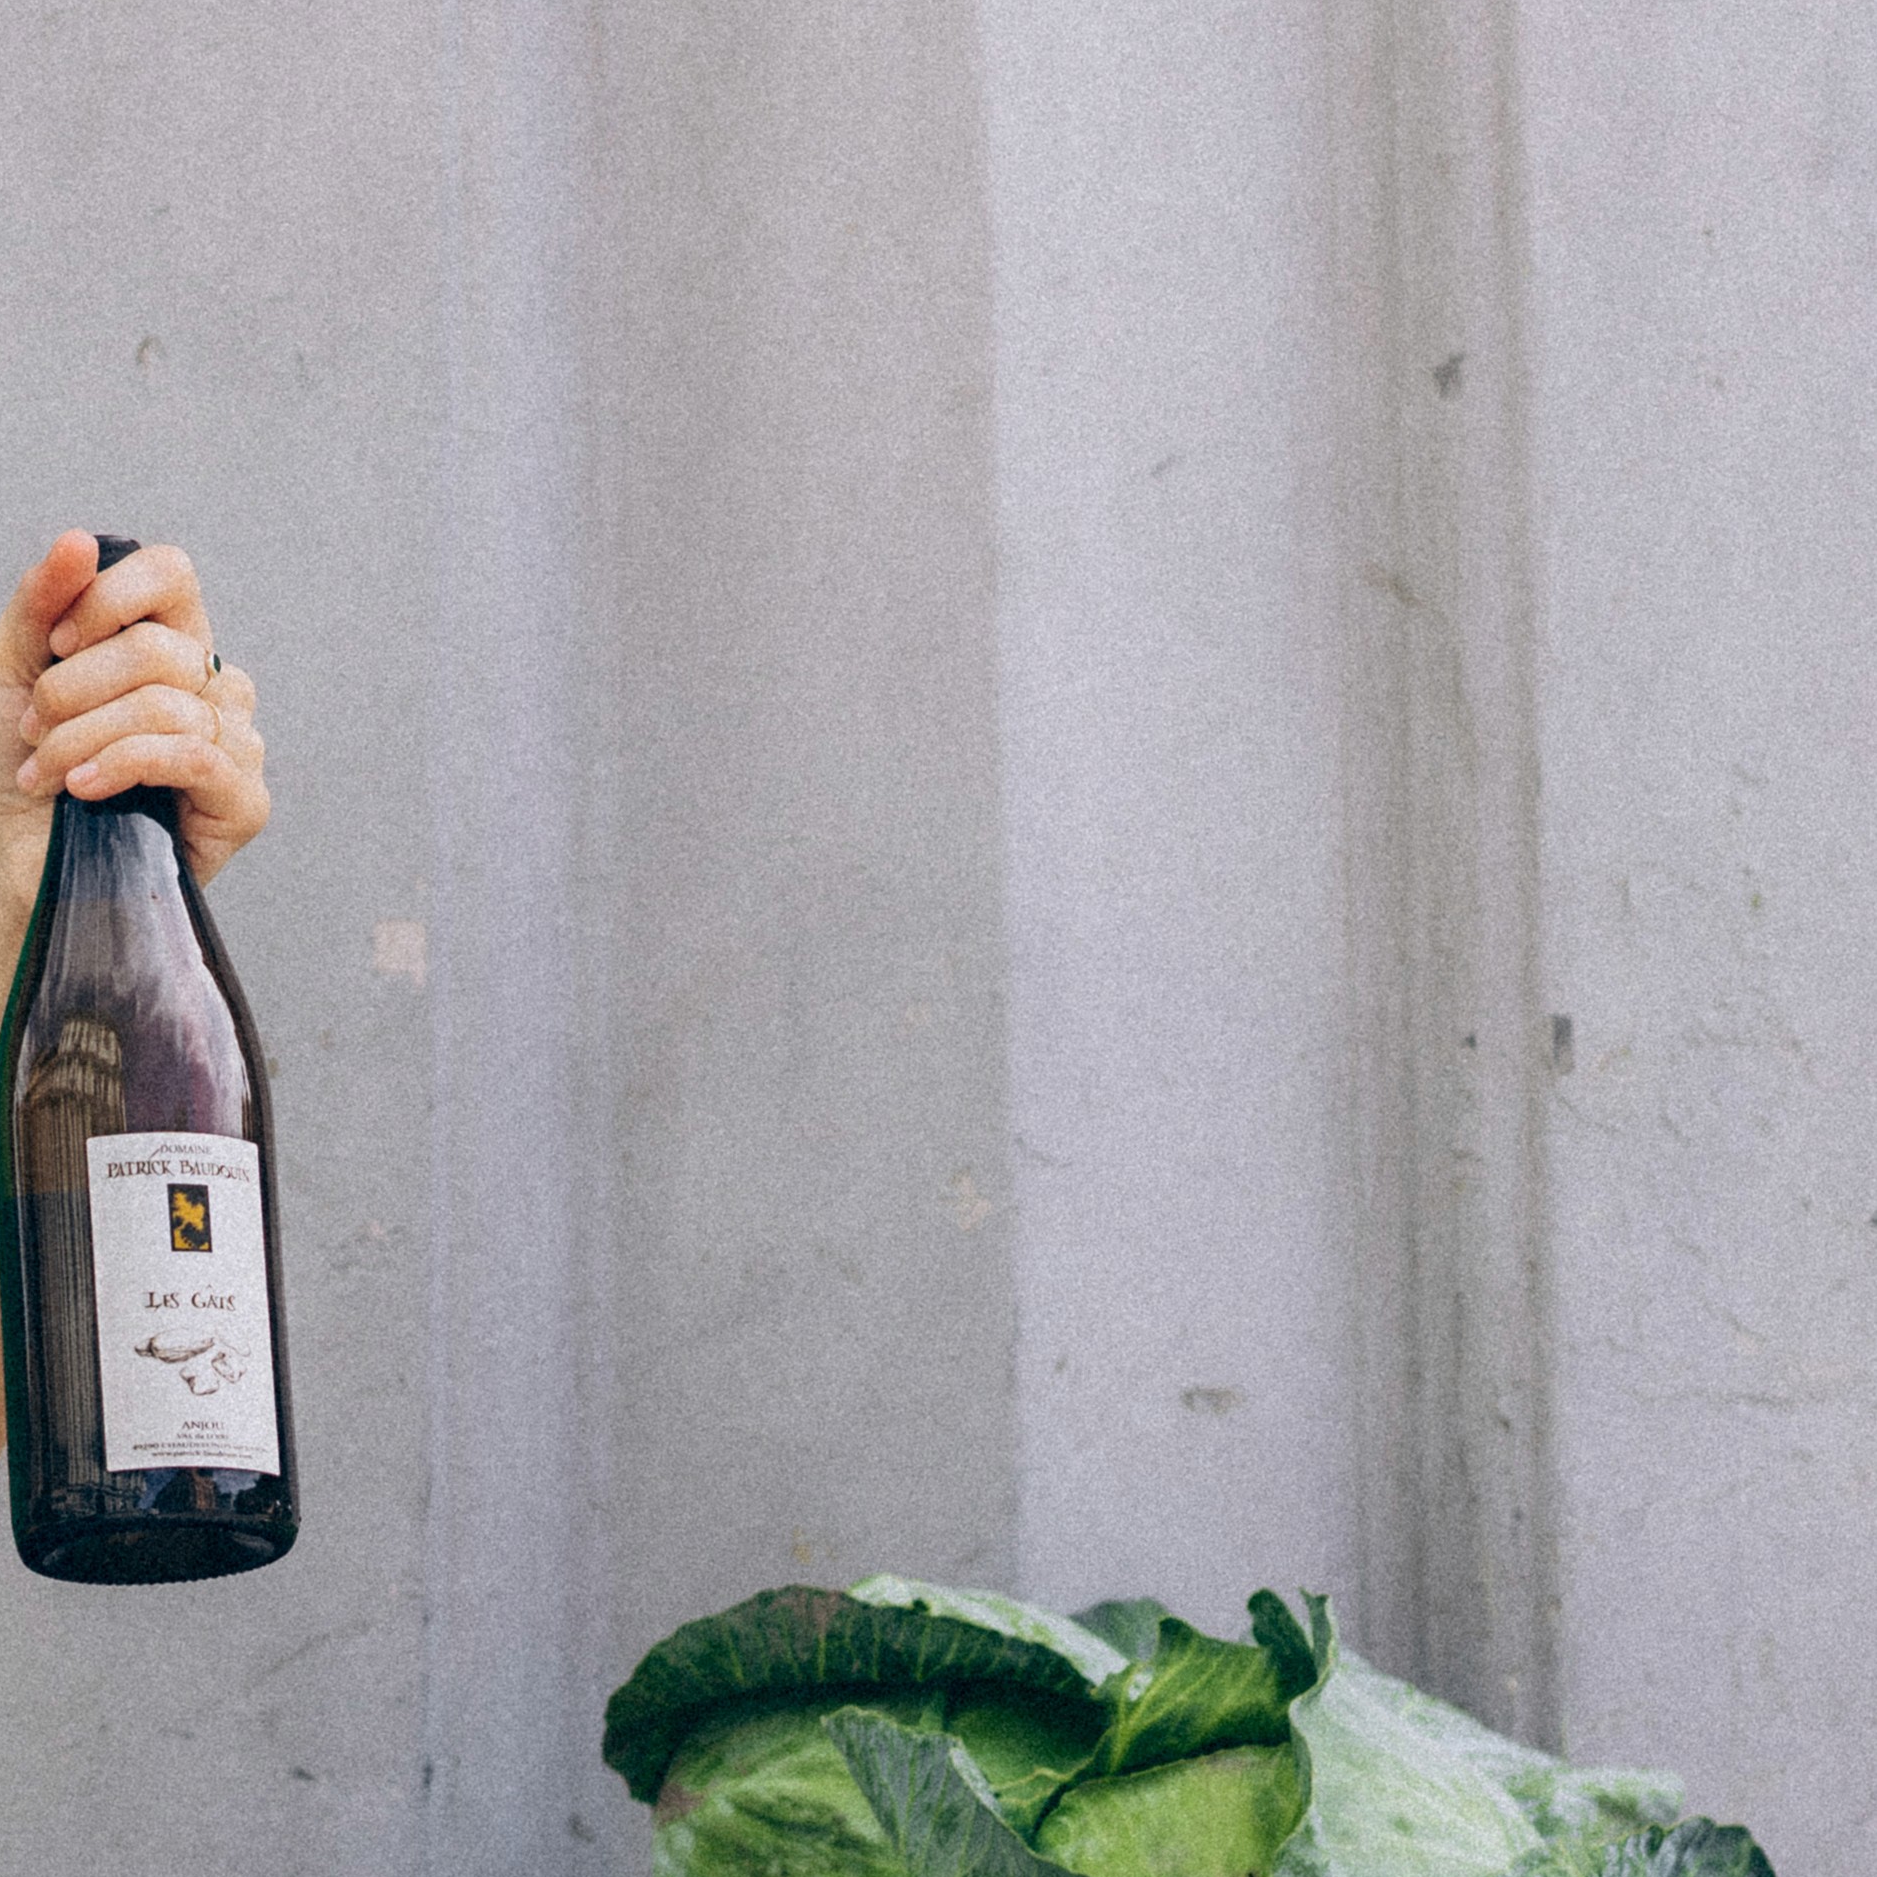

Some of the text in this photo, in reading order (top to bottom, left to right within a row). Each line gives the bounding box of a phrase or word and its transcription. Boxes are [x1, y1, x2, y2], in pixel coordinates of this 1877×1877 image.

[160, 1144, 212, 1155] DOMAINE
[106, 1159, 175, 1179] PATRICK
[144, 1291, 180, 1311] LES
[182, 1421, 224, 1430] ANJOU
